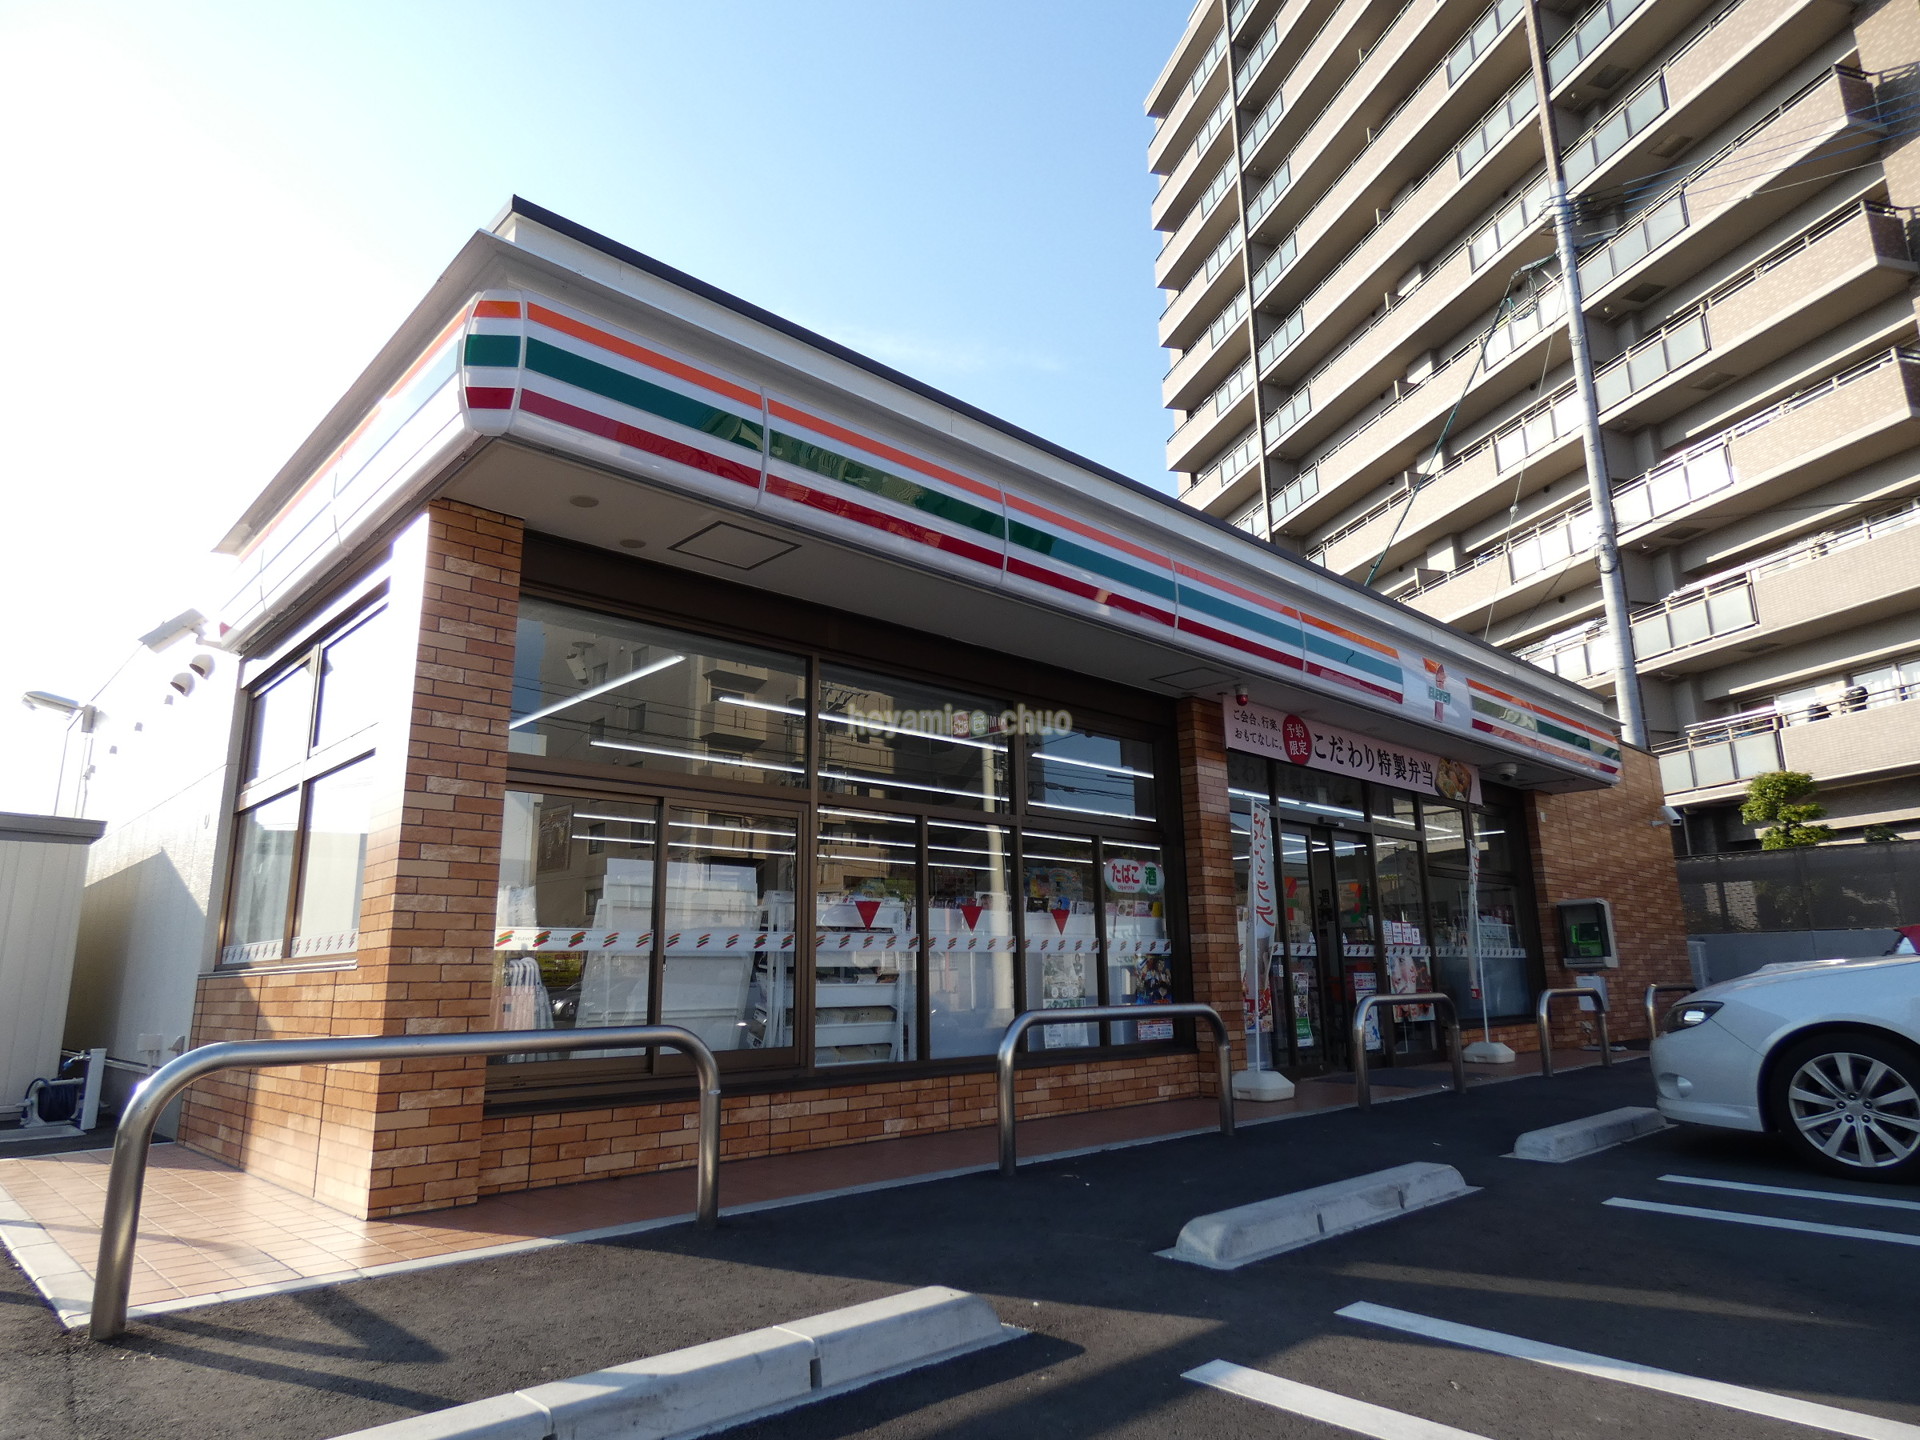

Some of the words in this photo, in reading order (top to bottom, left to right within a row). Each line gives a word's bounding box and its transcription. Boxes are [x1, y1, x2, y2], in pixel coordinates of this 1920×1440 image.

[1234, 728, 1282, 751] おもてなしに。
[1286, 723, 1304, 738] 予約
[1289, 740, 1308, 755] 限定
[1313, 733, 1433, 787] こだわり特製弁当
[1111, 863, 1140, 884] たばこ
[1145, 866, 1157, 886] 酒
